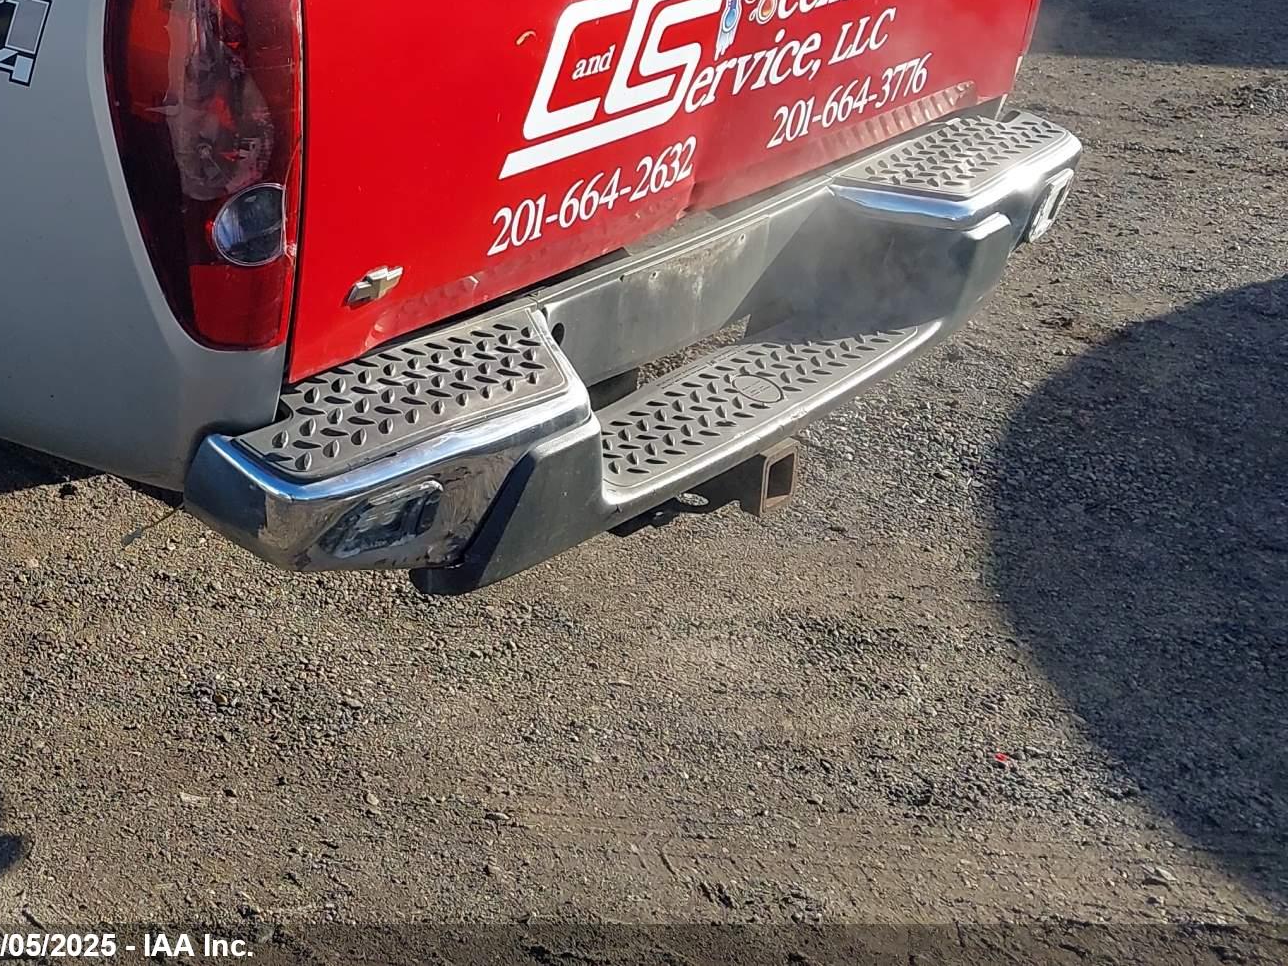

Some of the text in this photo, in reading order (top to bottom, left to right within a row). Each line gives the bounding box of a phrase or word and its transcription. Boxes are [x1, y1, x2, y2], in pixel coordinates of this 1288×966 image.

[572, 45, 616, 80] and
[828, 7, 896, 66] LLC
[766, 53, 932, 149] 201-664-3776
[487, 135, 697, 256] 201-664-2632
